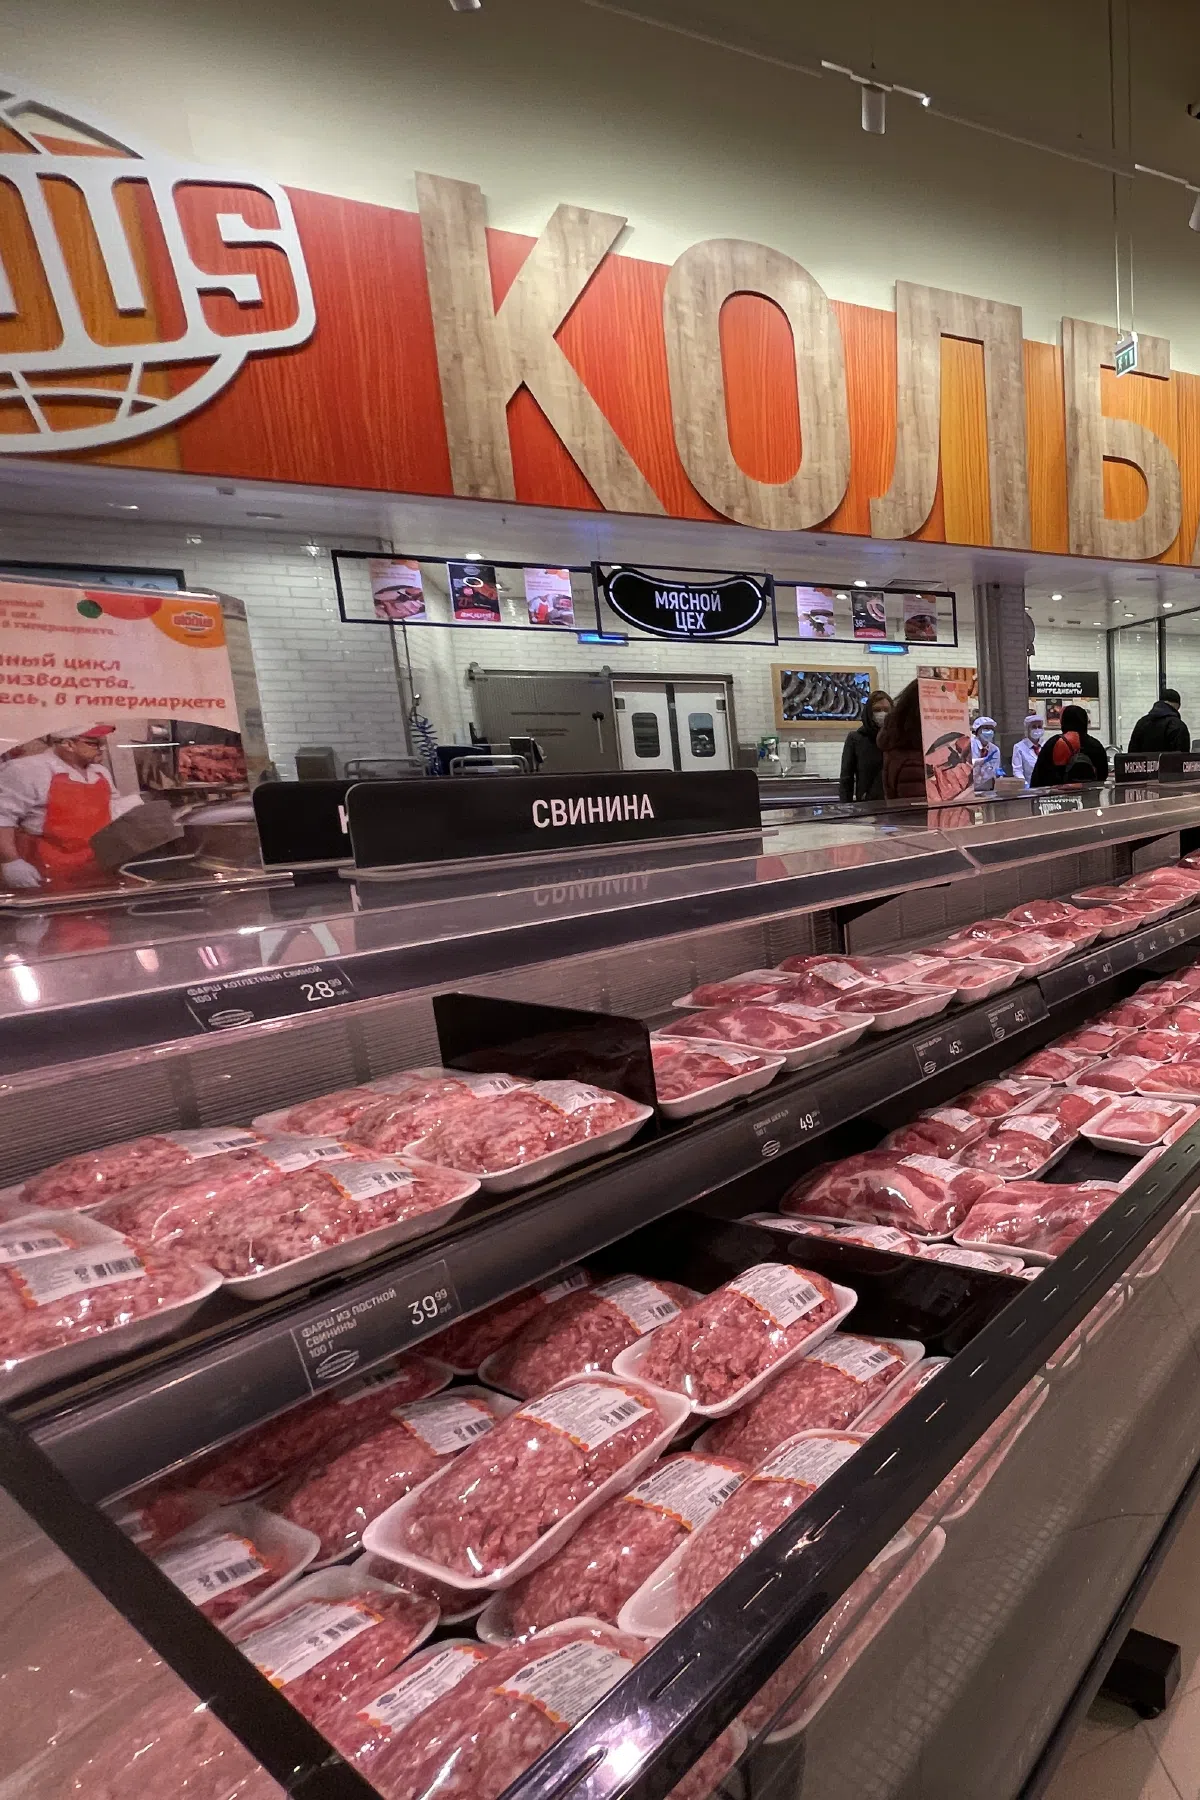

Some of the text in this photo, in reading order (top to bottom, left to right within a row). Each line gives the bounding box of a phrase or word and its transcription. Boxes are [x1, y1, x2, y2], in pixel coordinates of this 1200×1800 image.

[654, 590, 722, 612] МЯСНОЙ
[675, 611, 706, 632] ЦЕХ
[64, 658, 121, 672] цикл
[1036, 674, 1060, 682] ТОЛЬКО
[1036, 681, 1082, 689] НАТУРАЛЬНЫЕ
[55, 692, 67, 706] в
[75, 694, 226, 712] гипермаркете
[1124, 761, 1146, 773] МЯСНЫЕ
[532, 793, 655, 828] СВИНИНА
[187, 965, 323, 996] ФАРШ КОТЛЕТНЫЙ СВИНОЙ
[193, 994, 212, 1004] 100
[800, 1113, 814, 1131] 49
[302, 1287, 398, 1338] ФАРШ ИЗ ПОСТНОЙ
[407, 1295, 439, 1326] 39
[306, 1320, 358, 1348] СВИНИНЫ
[309, 1344, 328, 1359] 100
